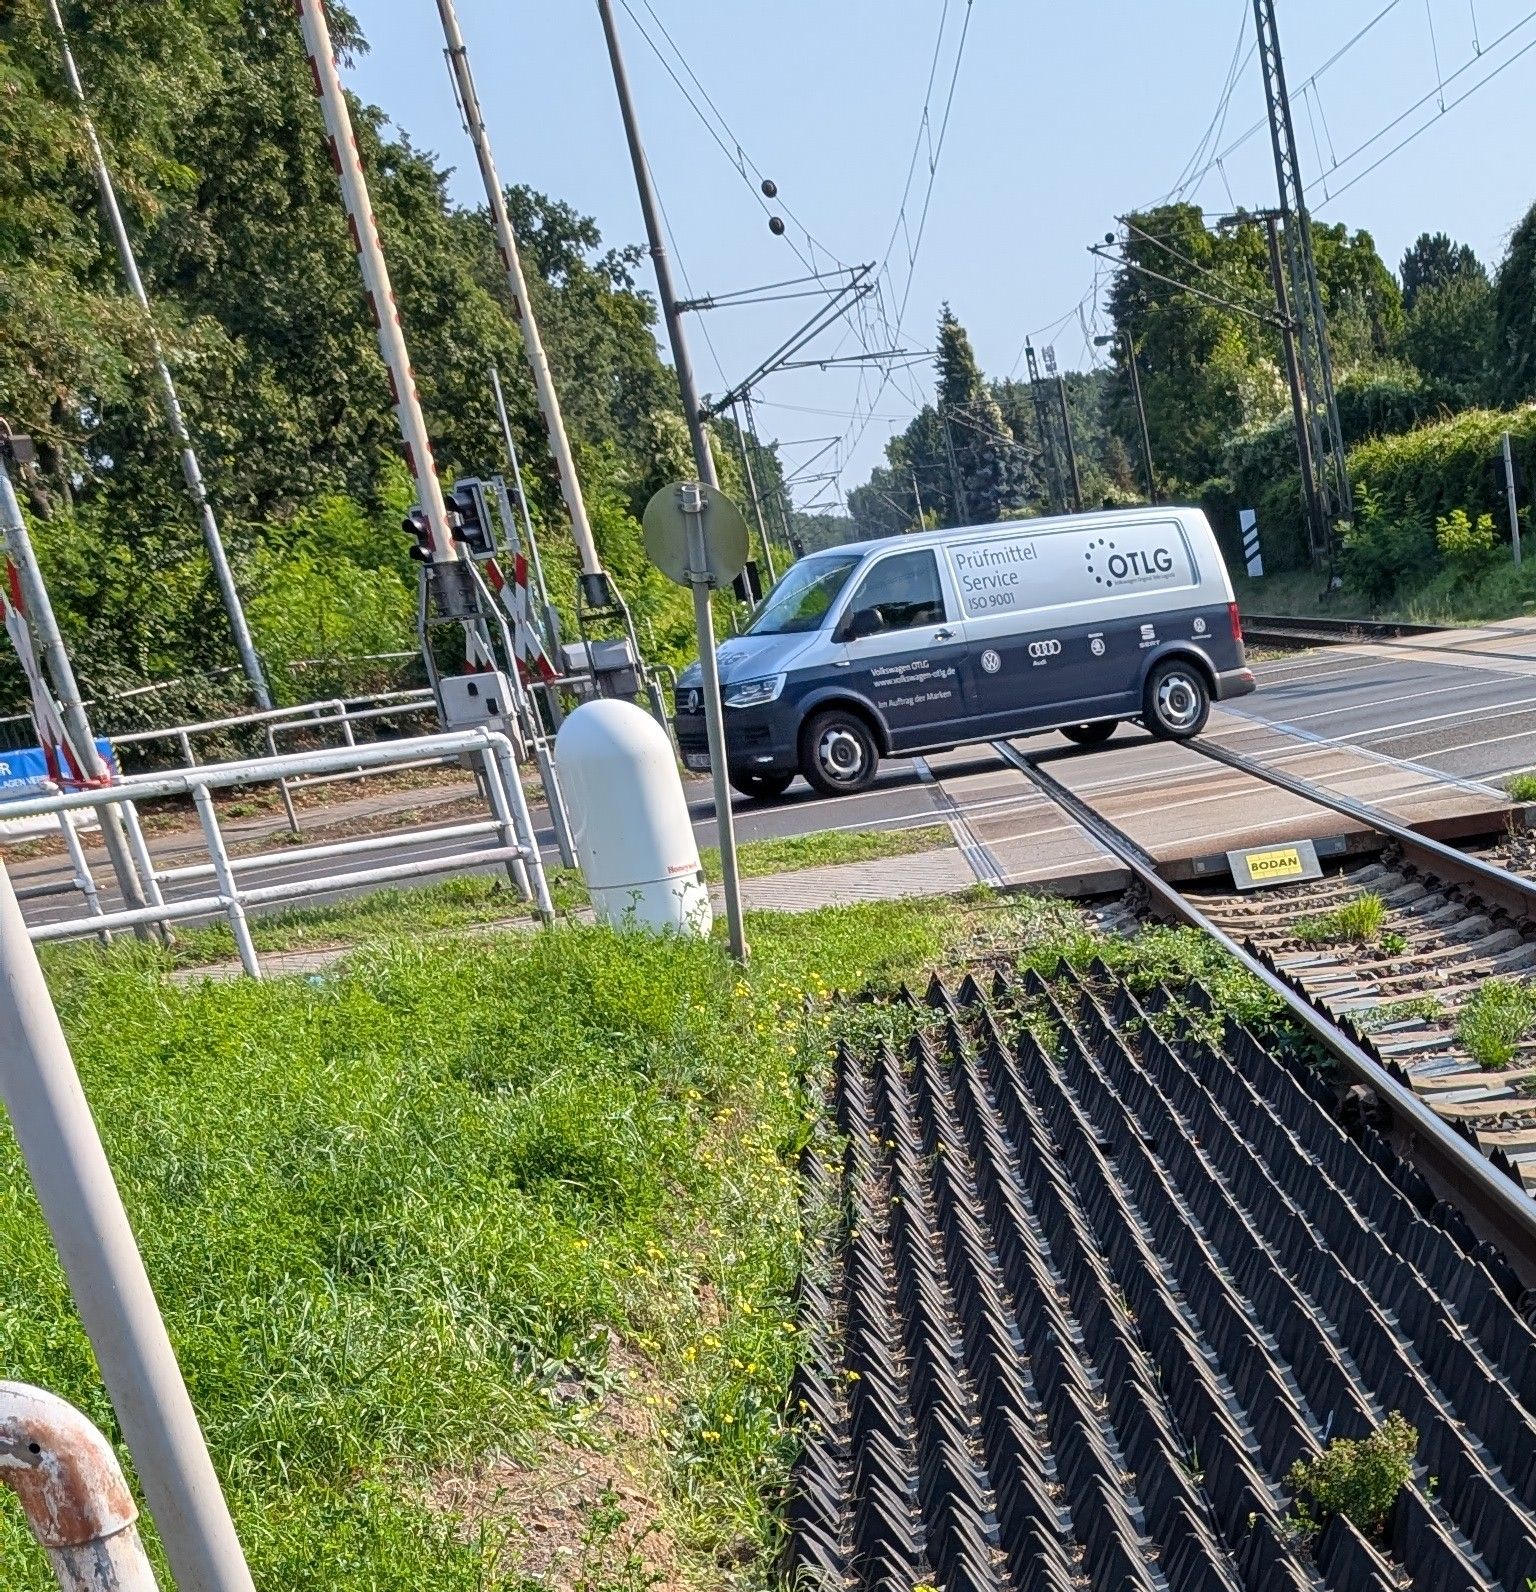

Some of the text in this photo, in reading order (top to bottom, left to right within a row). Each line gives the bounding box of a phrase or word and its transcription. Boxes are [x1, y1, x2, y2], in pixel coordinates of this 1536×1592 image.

[955, 542, 1038, 570] Prüfmittel
[1108, 548, 1173, 578] OTLG
[962, 570, 1019, 592] Service
[968, 592, 1016, 610] ISO 9001
[871, 660, 930, 676] Volkswagen OTLG
[927, 690, 952, 701] Marken
[1251, 857, 1298, 871] BODAN
